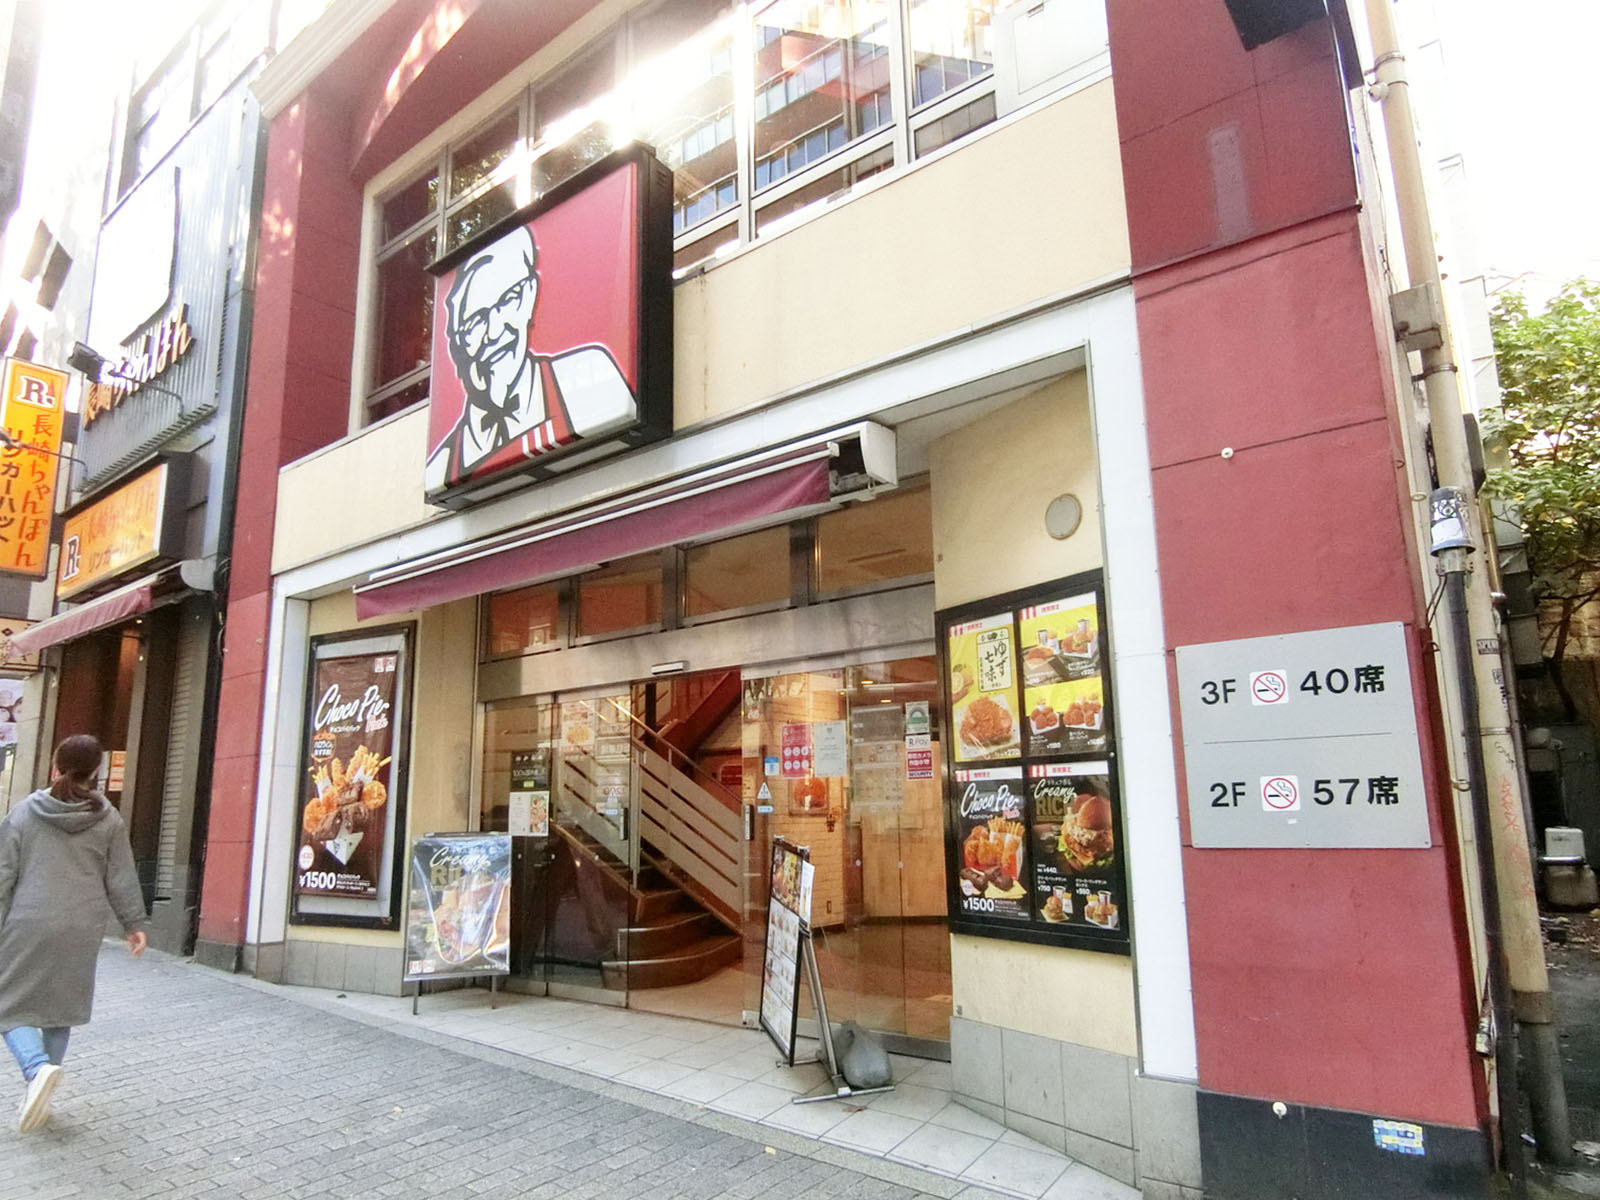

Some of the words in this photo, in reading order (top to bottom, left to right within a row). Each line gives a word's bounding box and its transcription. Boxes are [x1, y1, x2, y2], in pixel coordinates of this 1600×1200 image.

[15, 414, 53, 567] 長崎ちゃんぽん
[1201, 679, 1236, 705] 3F
[1300, 664, 1385, 696] 40席
[315, 684, 360, 731] Choco
[357, 685, 390, 722] Pie
[960, 782, 995, 817] Choco
[995, 784, 1019, 812] Pie
[1034, 779, 1077, 804] Creamy
[1210, 782, 1246, 807] 2F
[1313, 776, 1399, 806] 57席
[430, 847, 491, 872] Creamy
[299, 871, 336, 890] ¥1500
[963, 897, 994, 911] ¥1500
